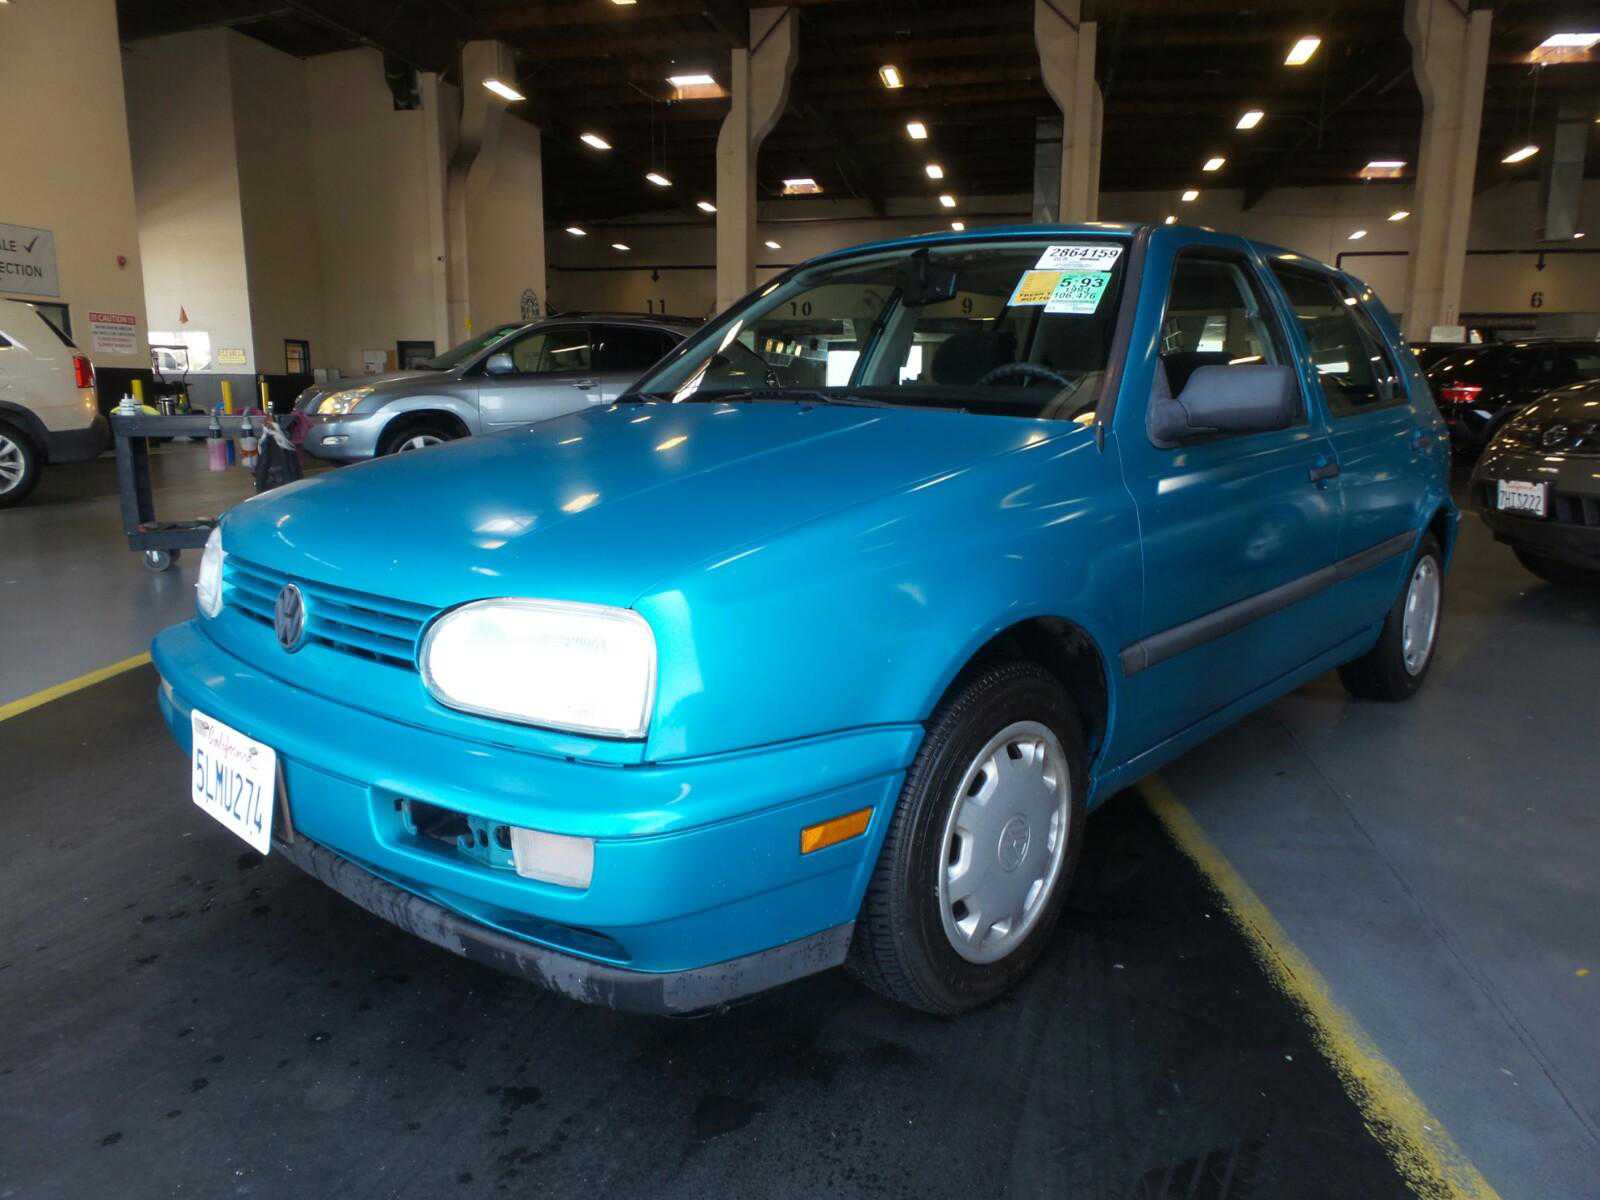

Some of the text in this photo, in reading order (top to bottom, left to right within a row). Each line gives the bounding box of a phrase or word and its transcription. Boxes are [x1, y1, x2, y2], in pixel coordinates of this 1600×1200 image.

[1050, 248, 1118, 258] 2864159
[646, 299, 665, 314] 11
[961, 300, 973, 314] 9
[1530, 291, 1543, 308] 6
[789, 301, 812, 317] 10
[196, 748, 263, 833] 5LMU274
